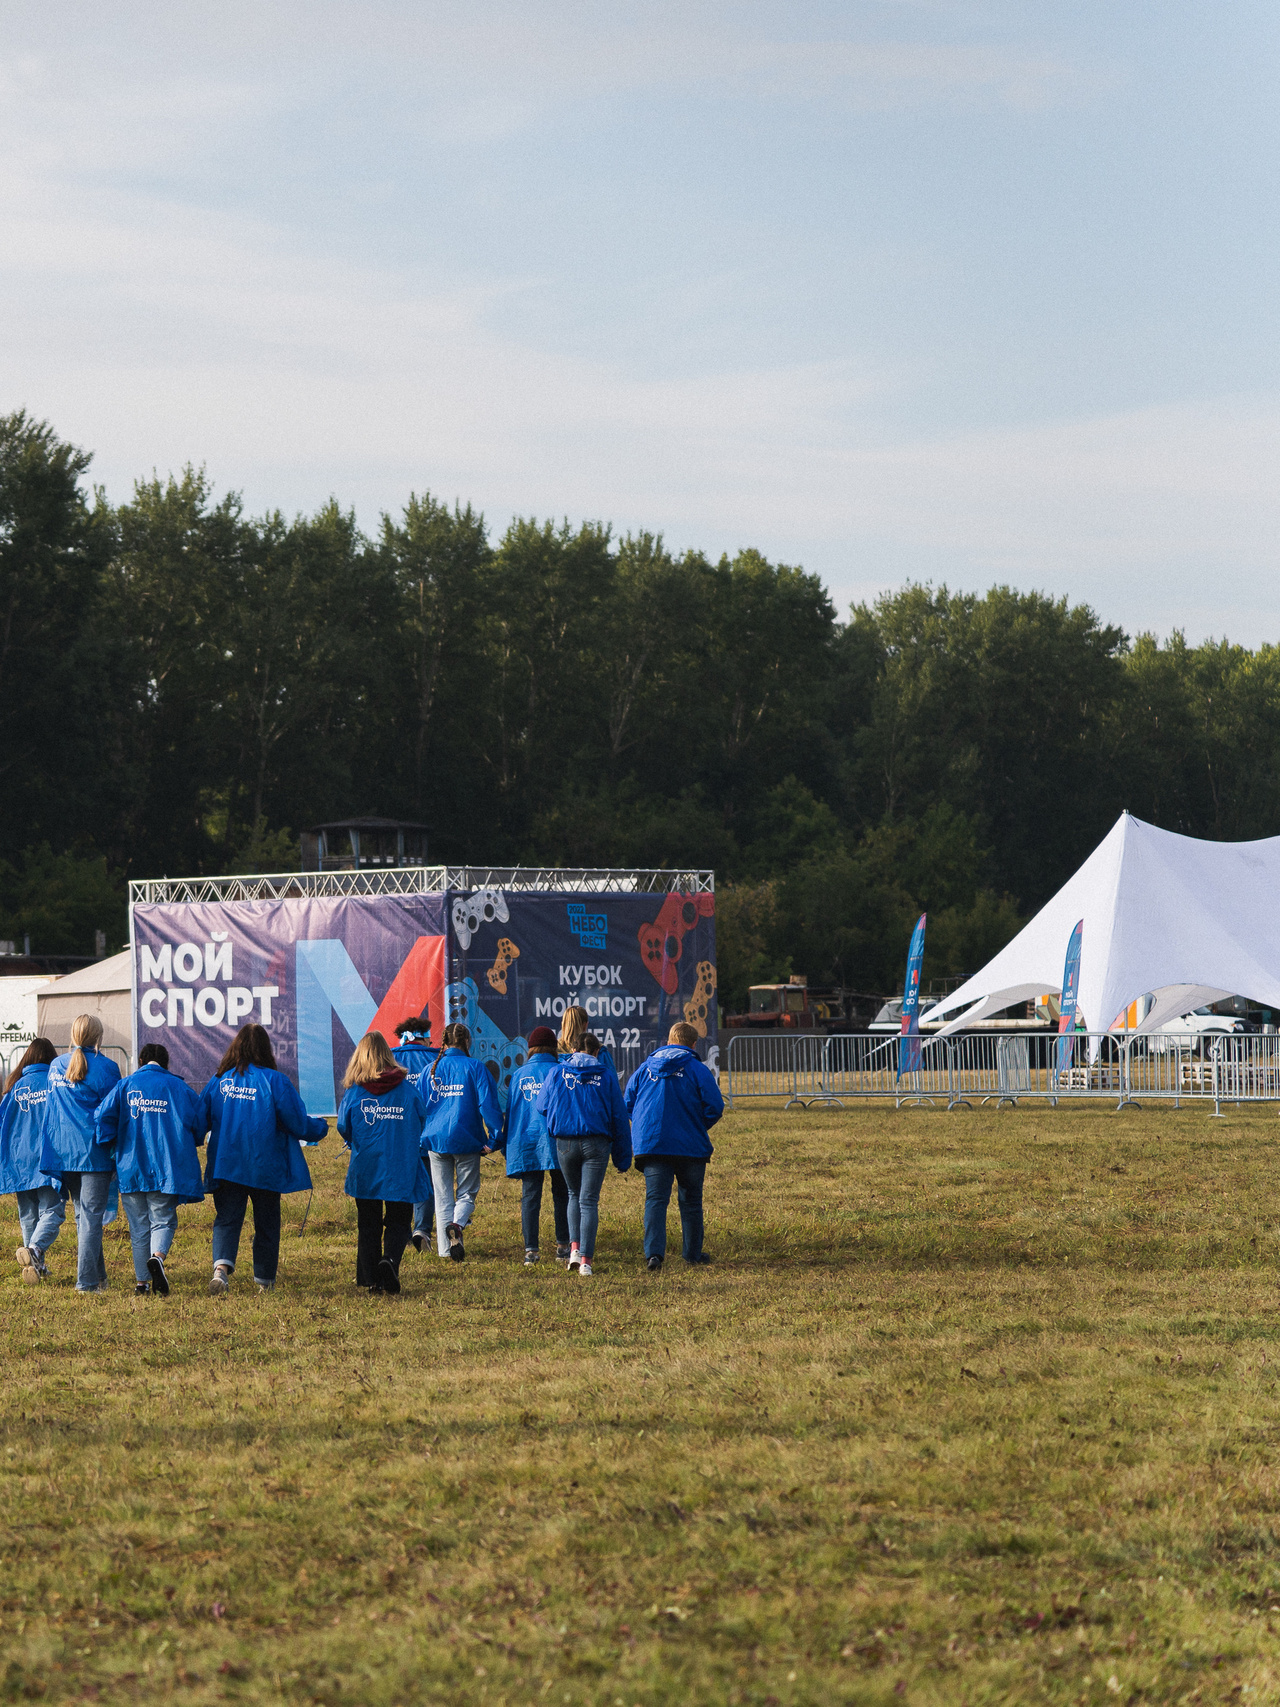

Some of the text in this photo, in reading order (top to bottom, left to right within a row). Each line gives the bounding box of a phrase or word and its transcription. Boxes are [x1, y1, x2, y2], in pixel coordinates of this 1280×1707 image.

[569, 905, 585, 914] 2022
[571, 916, 606, 932] НЕБО
[581, 934, 605, 947] ФЕСТ
[141, 931, 233, 982] МОЙ
[559, 965, 623, 985] КУБОК
[141, 986, 279, 1028] СПОРТ
[585, 996, 646, 1017] СПОРТ
[621, 1028, 640, 1048] 22
[229, 1092, 256, 1101] Кузбасса
[140, 1105, 167, 1113] Кузбасса
